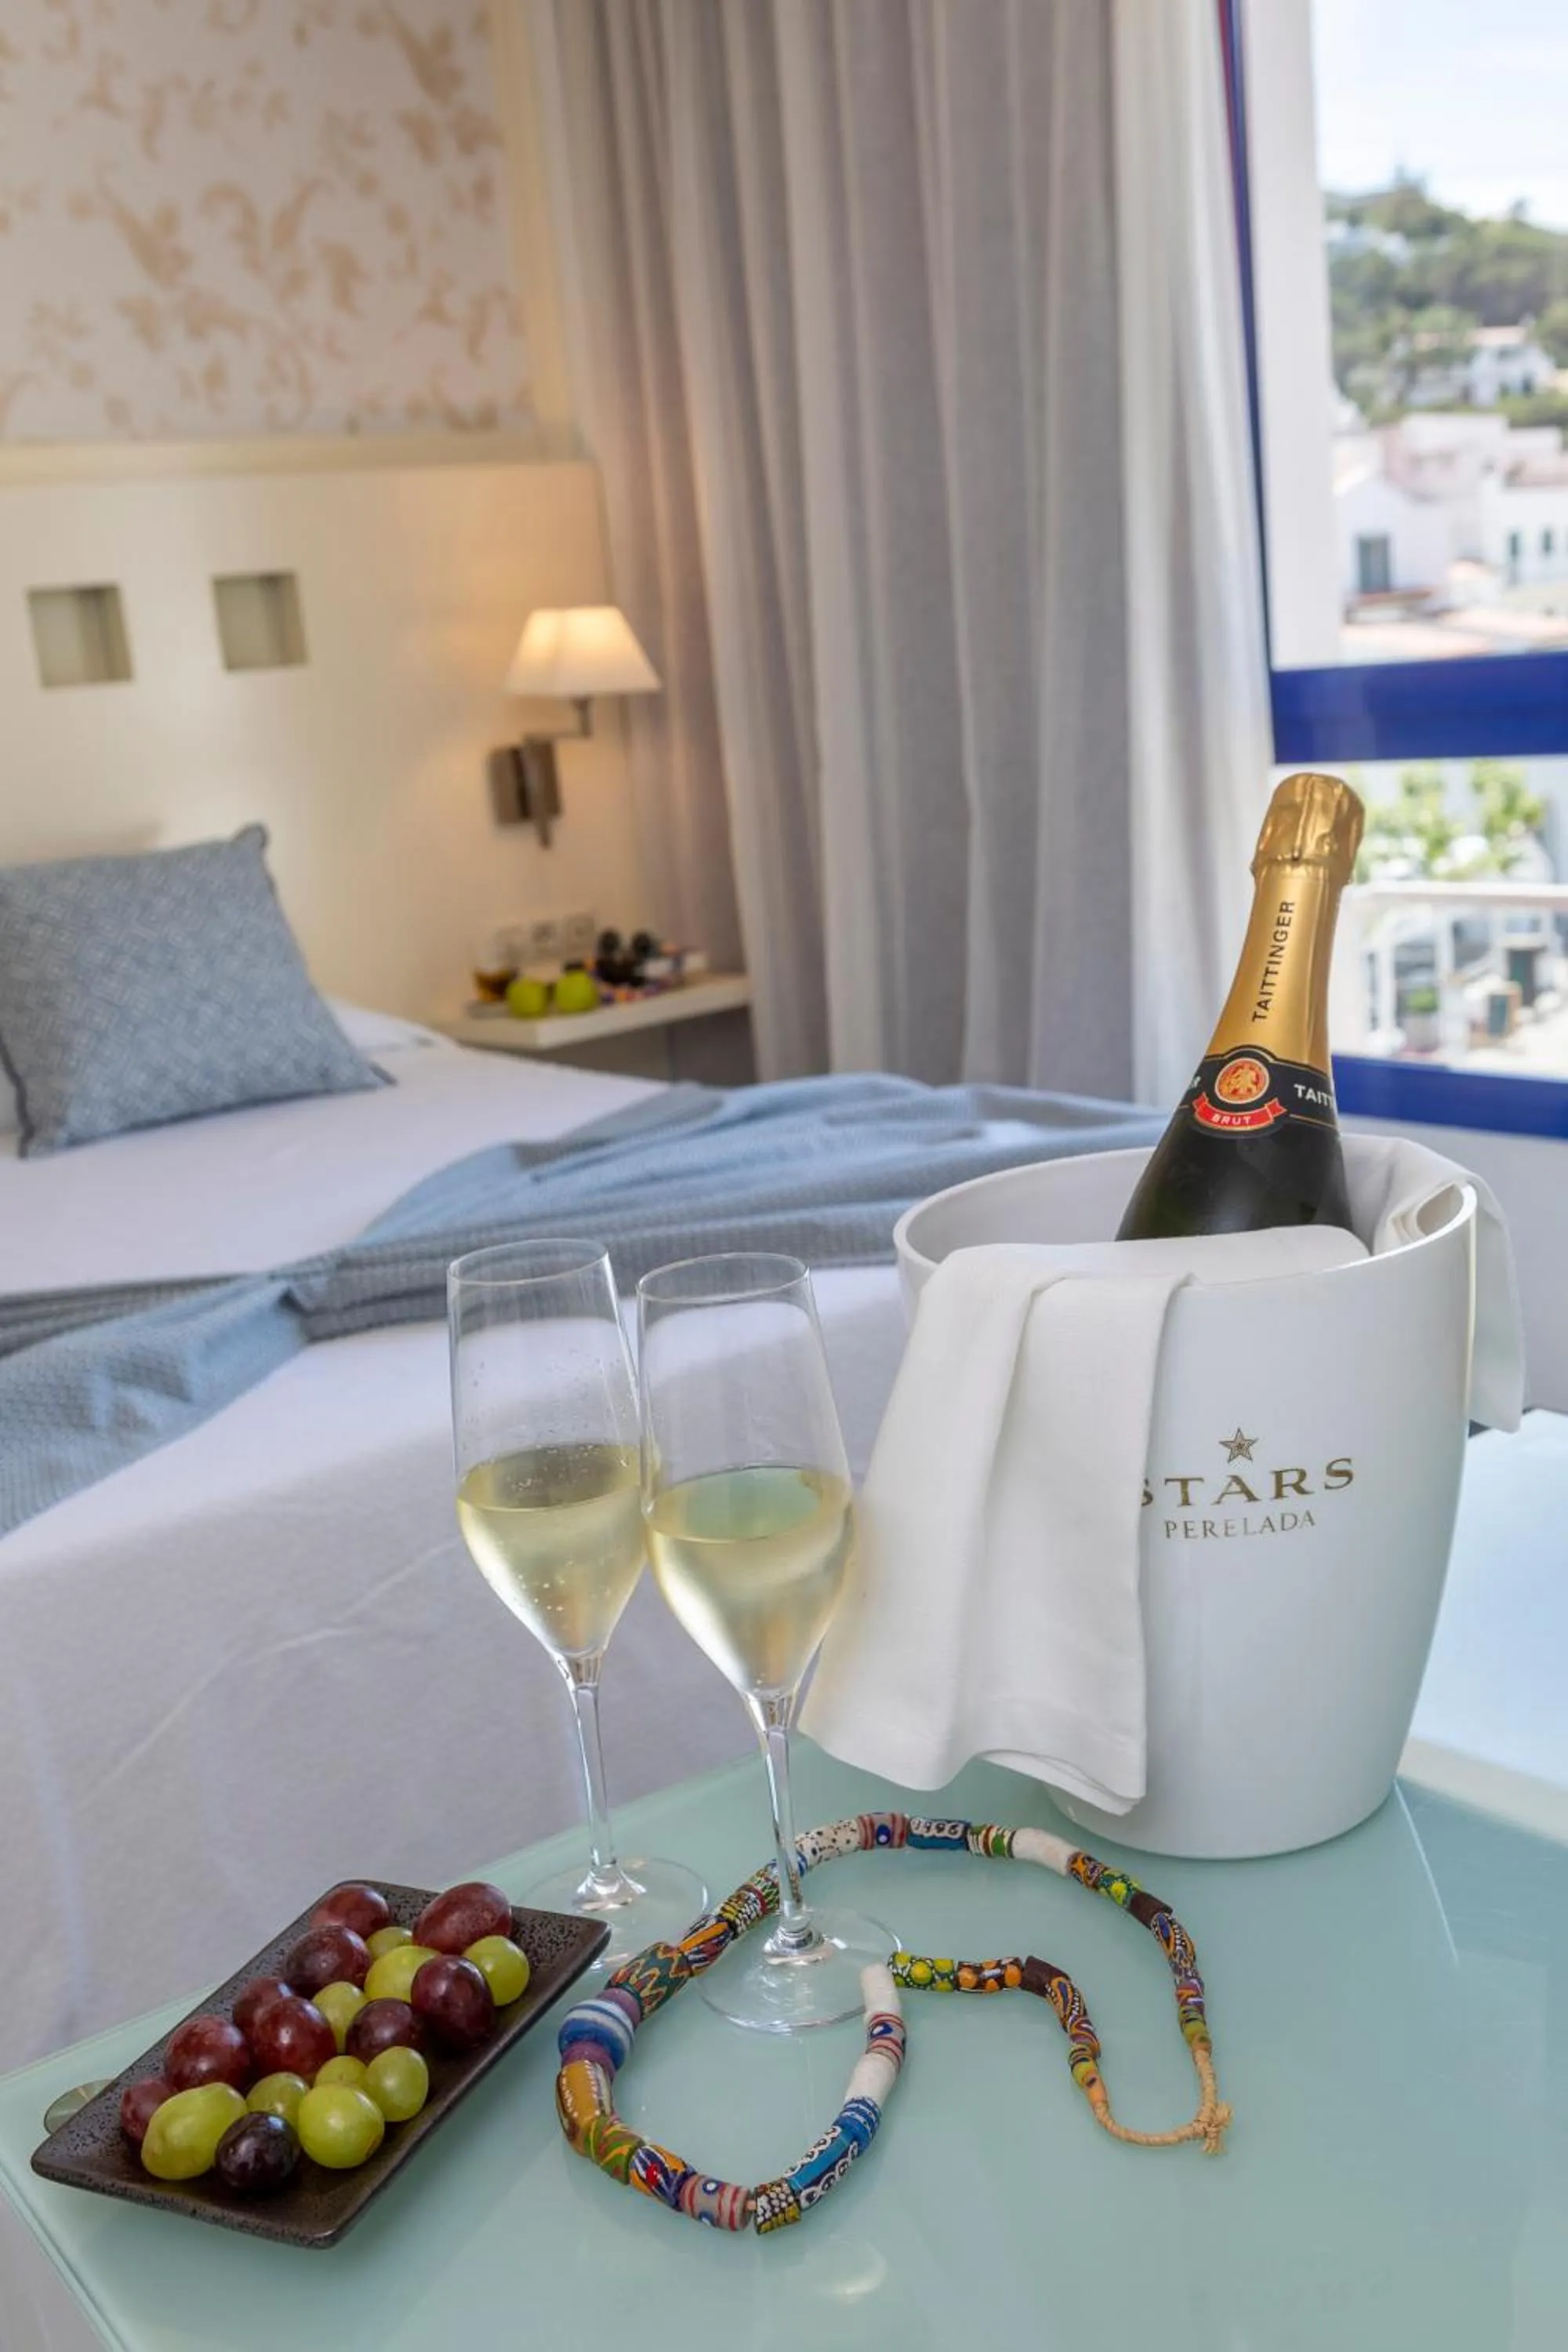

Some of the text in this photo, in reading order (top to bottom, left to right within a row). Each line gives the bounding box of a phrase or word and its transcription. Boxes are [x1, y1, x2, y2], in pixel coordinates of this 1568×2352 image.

[1252, 901, 1295, 1022] TAITTINGER
[1210, 1113, 1252, 1126] BRUT
[1164, 1509, 1316, 1539] PERELADA
